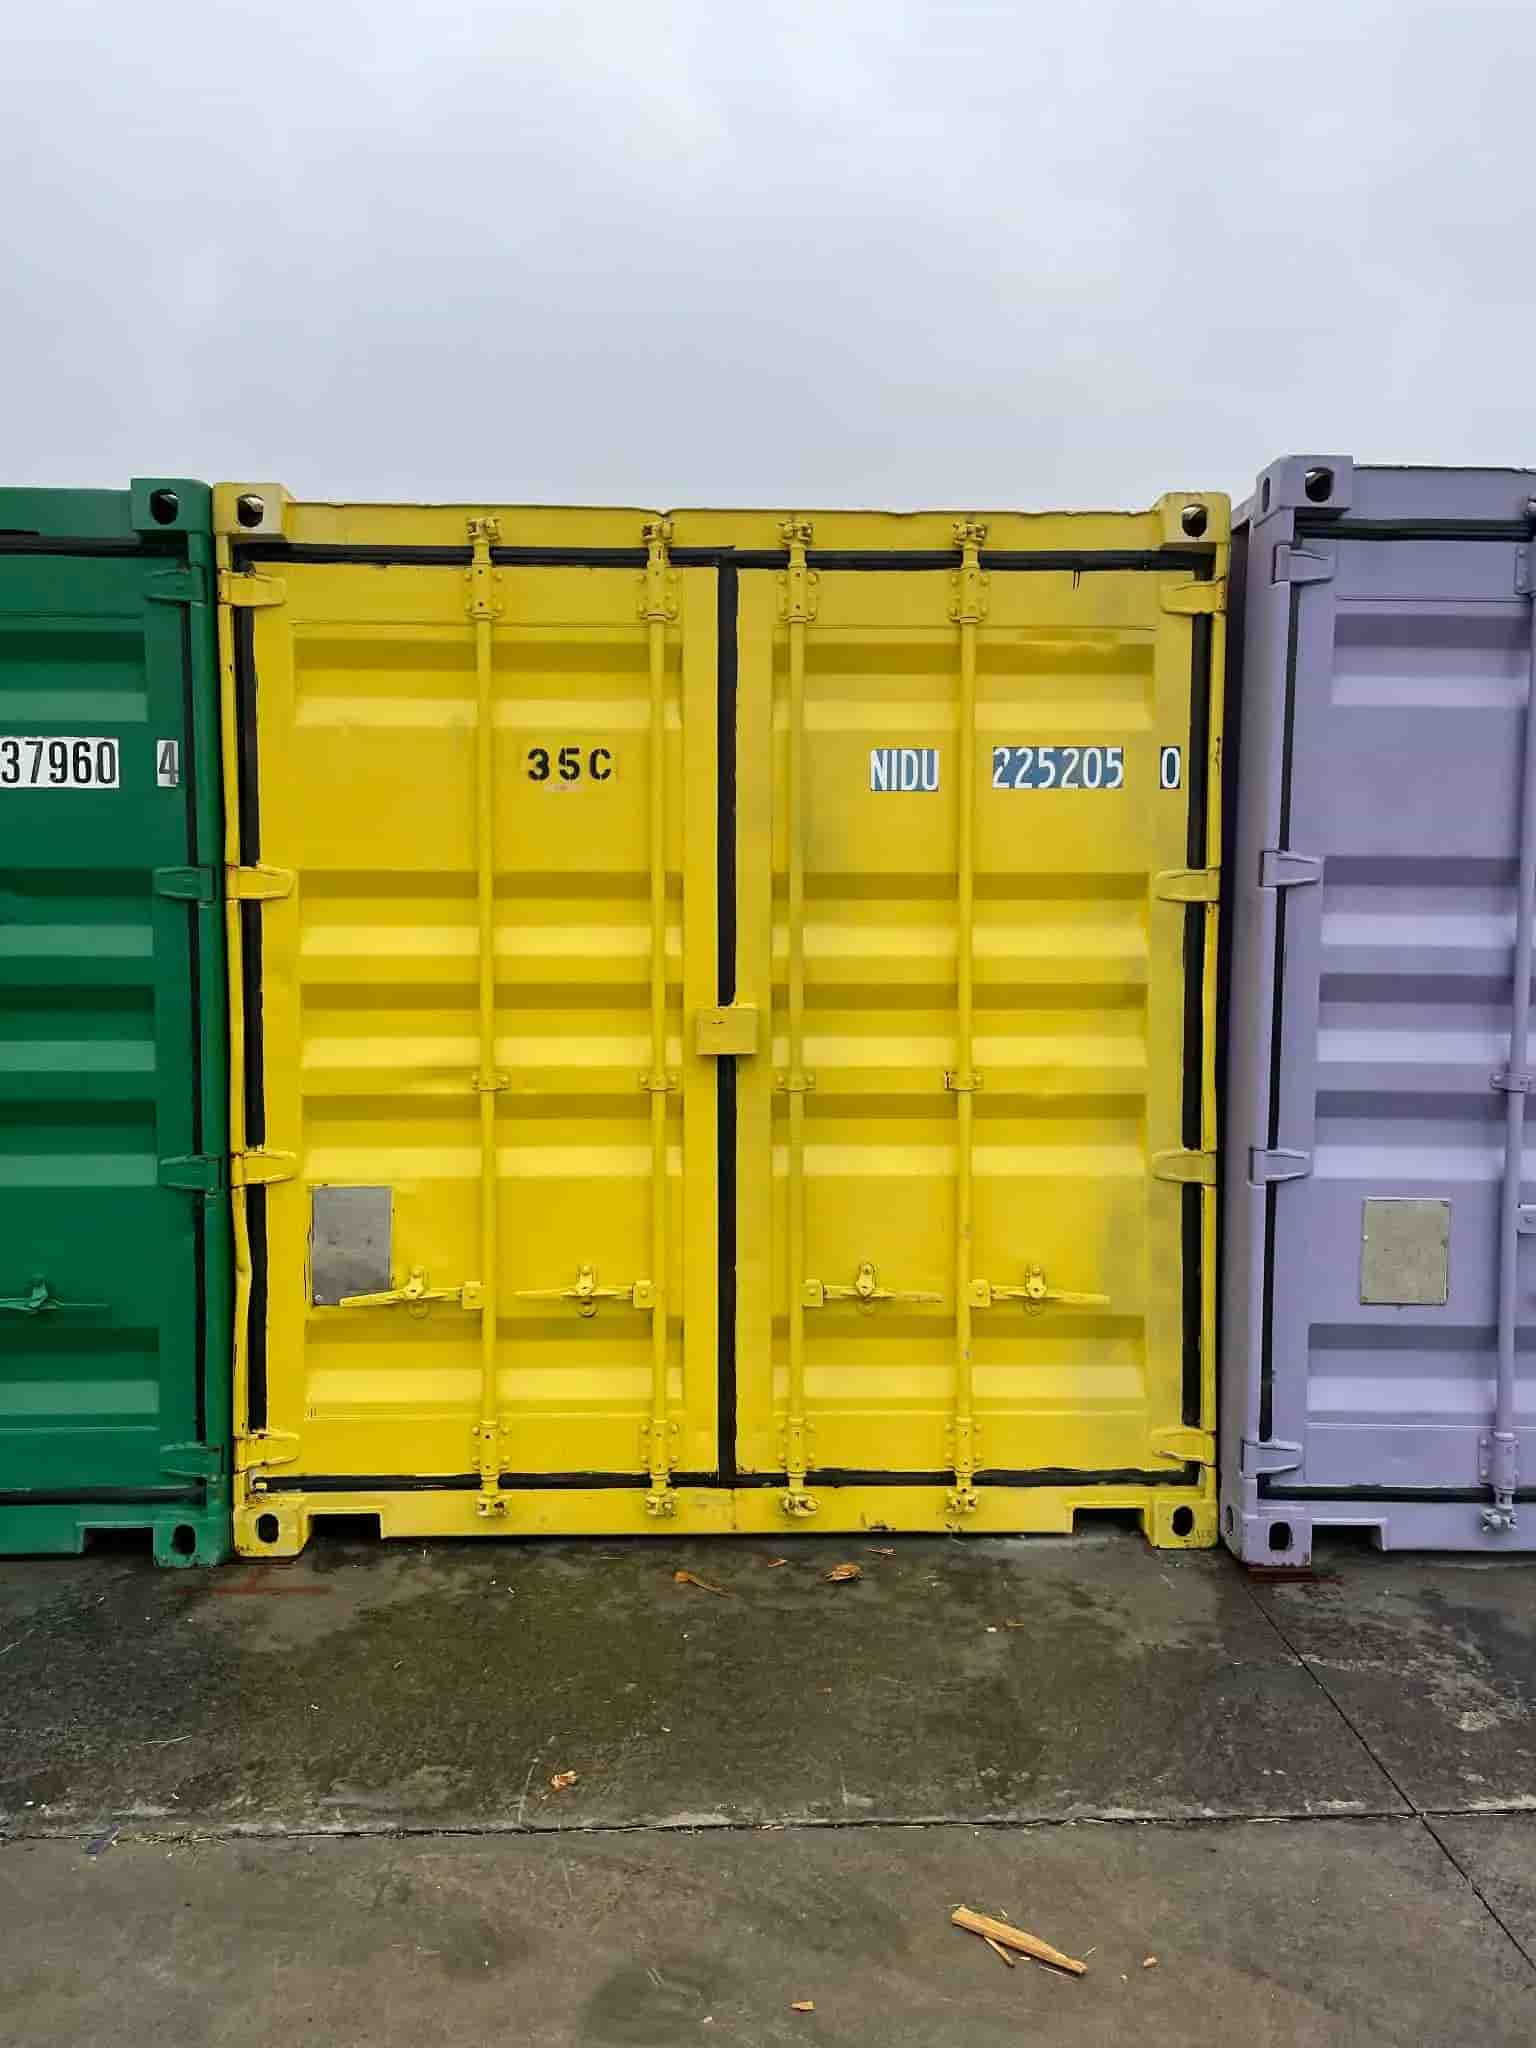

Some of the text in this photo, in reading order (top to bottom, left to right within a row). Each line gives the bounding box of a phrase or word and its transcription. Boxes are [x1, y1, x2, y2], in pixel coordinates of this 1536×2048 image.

[1, 740, 179, 784] 37960 4
[527, 747, 612, 781] 35C
[870, 747, 1181, 790] NIDU 225205 0
